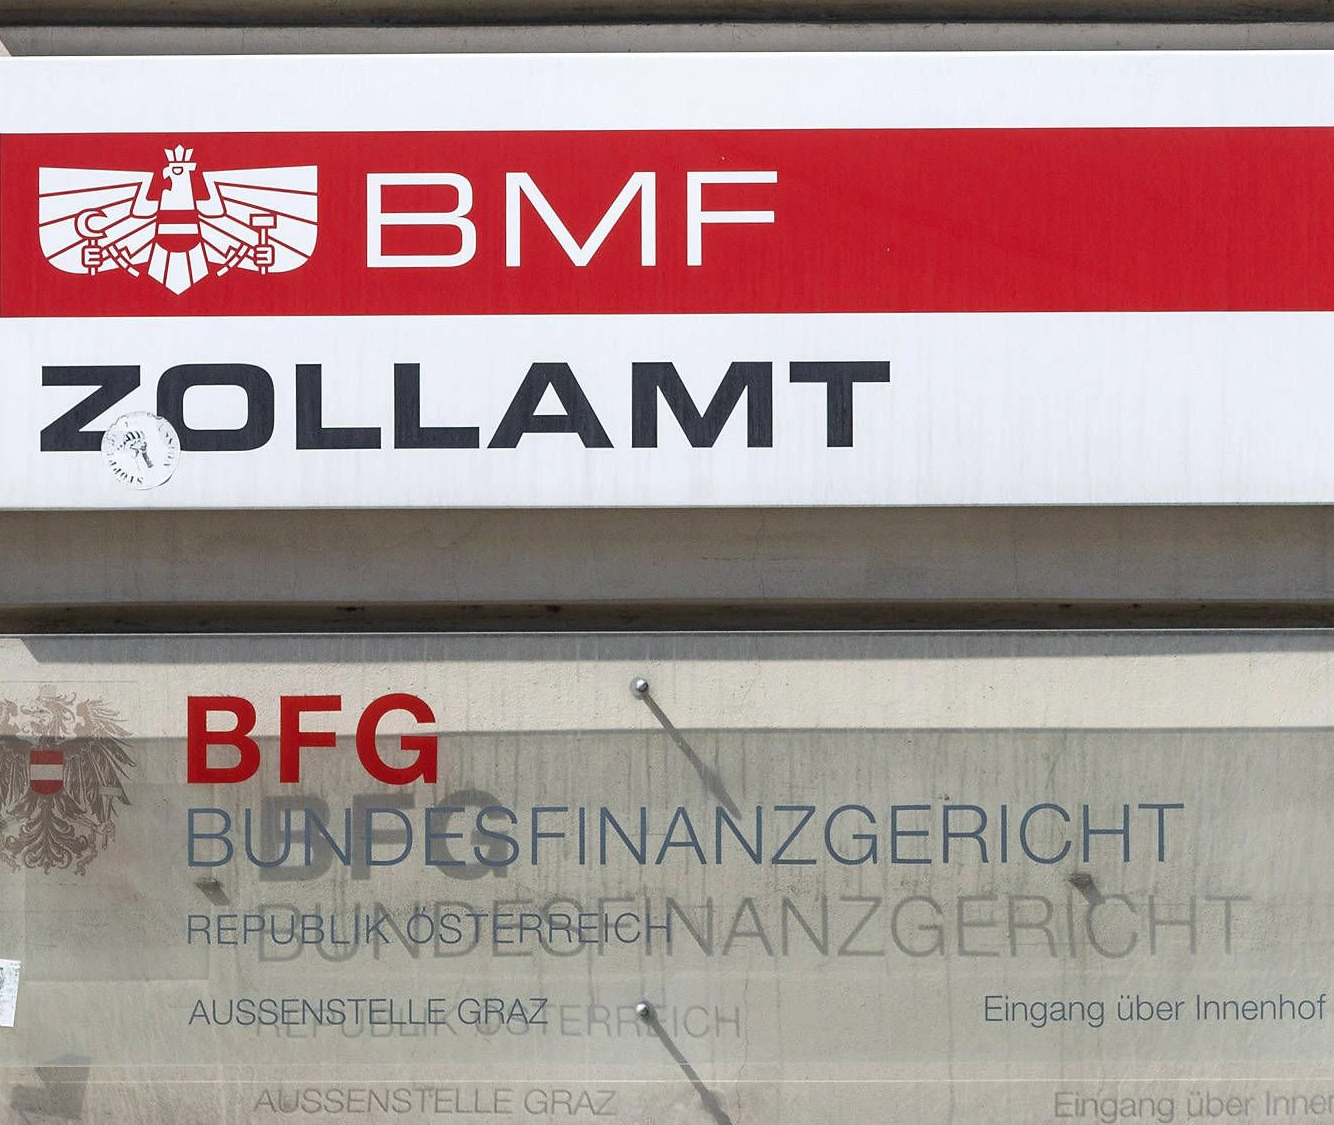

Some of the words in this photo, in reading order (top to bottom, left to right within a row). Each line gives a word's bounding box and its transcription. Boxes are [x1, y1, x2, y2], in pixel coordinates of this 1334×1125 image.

[366, 169, 779, 268] BMF
[39, 360, 891, 452] ZOLLAMT
[187, 693, 439, 785] BFG
[187, 802, 1184, 870] BUNDESFINANZGERICHT
[186, 913, 390, 946] REPUBLIK
[407, 907, 674, 946] ÖSTERREICH
[187, 997, 447, 1026] AUSSENSTELLE
[457, 997, 550, 1026] GRAZ
[983, 994, 1106, 1029] Eingang
[1116, 993, 1185, 1022] über
[1195, 992, 1328, 1022] Innenhof
